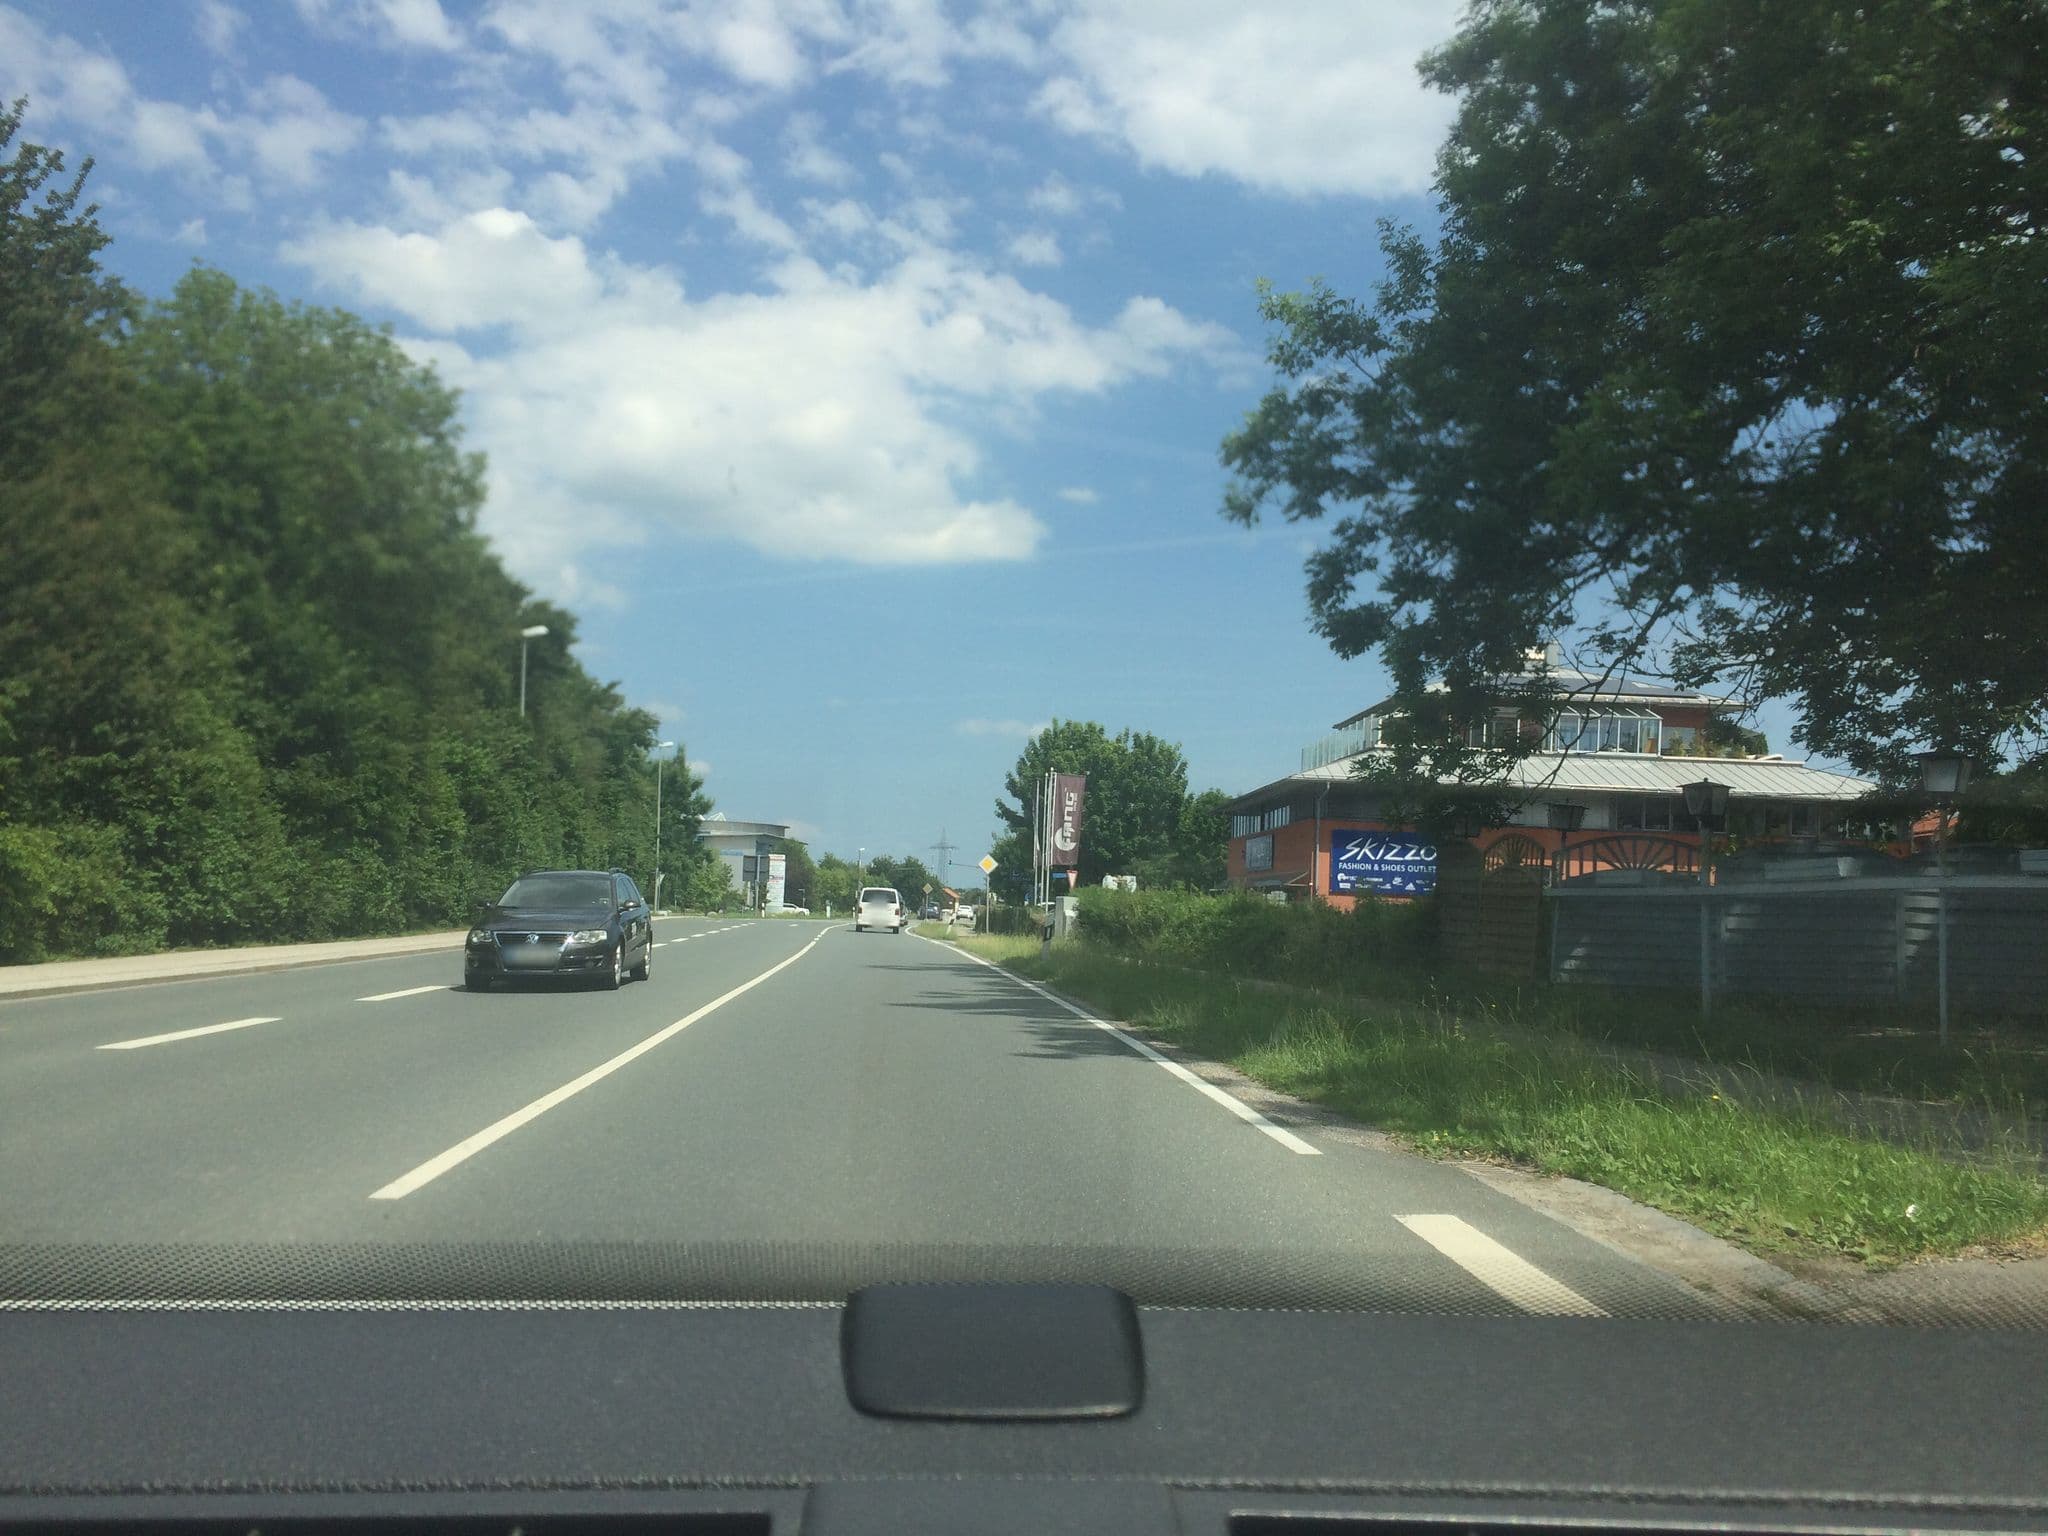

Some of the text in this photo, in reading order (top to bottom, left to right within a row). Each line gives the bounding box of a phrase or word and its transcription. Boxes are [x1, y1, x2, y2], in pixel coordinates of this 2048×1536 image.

[1338, 862, 1437, 874] FASHION & SHOES OUTLET
